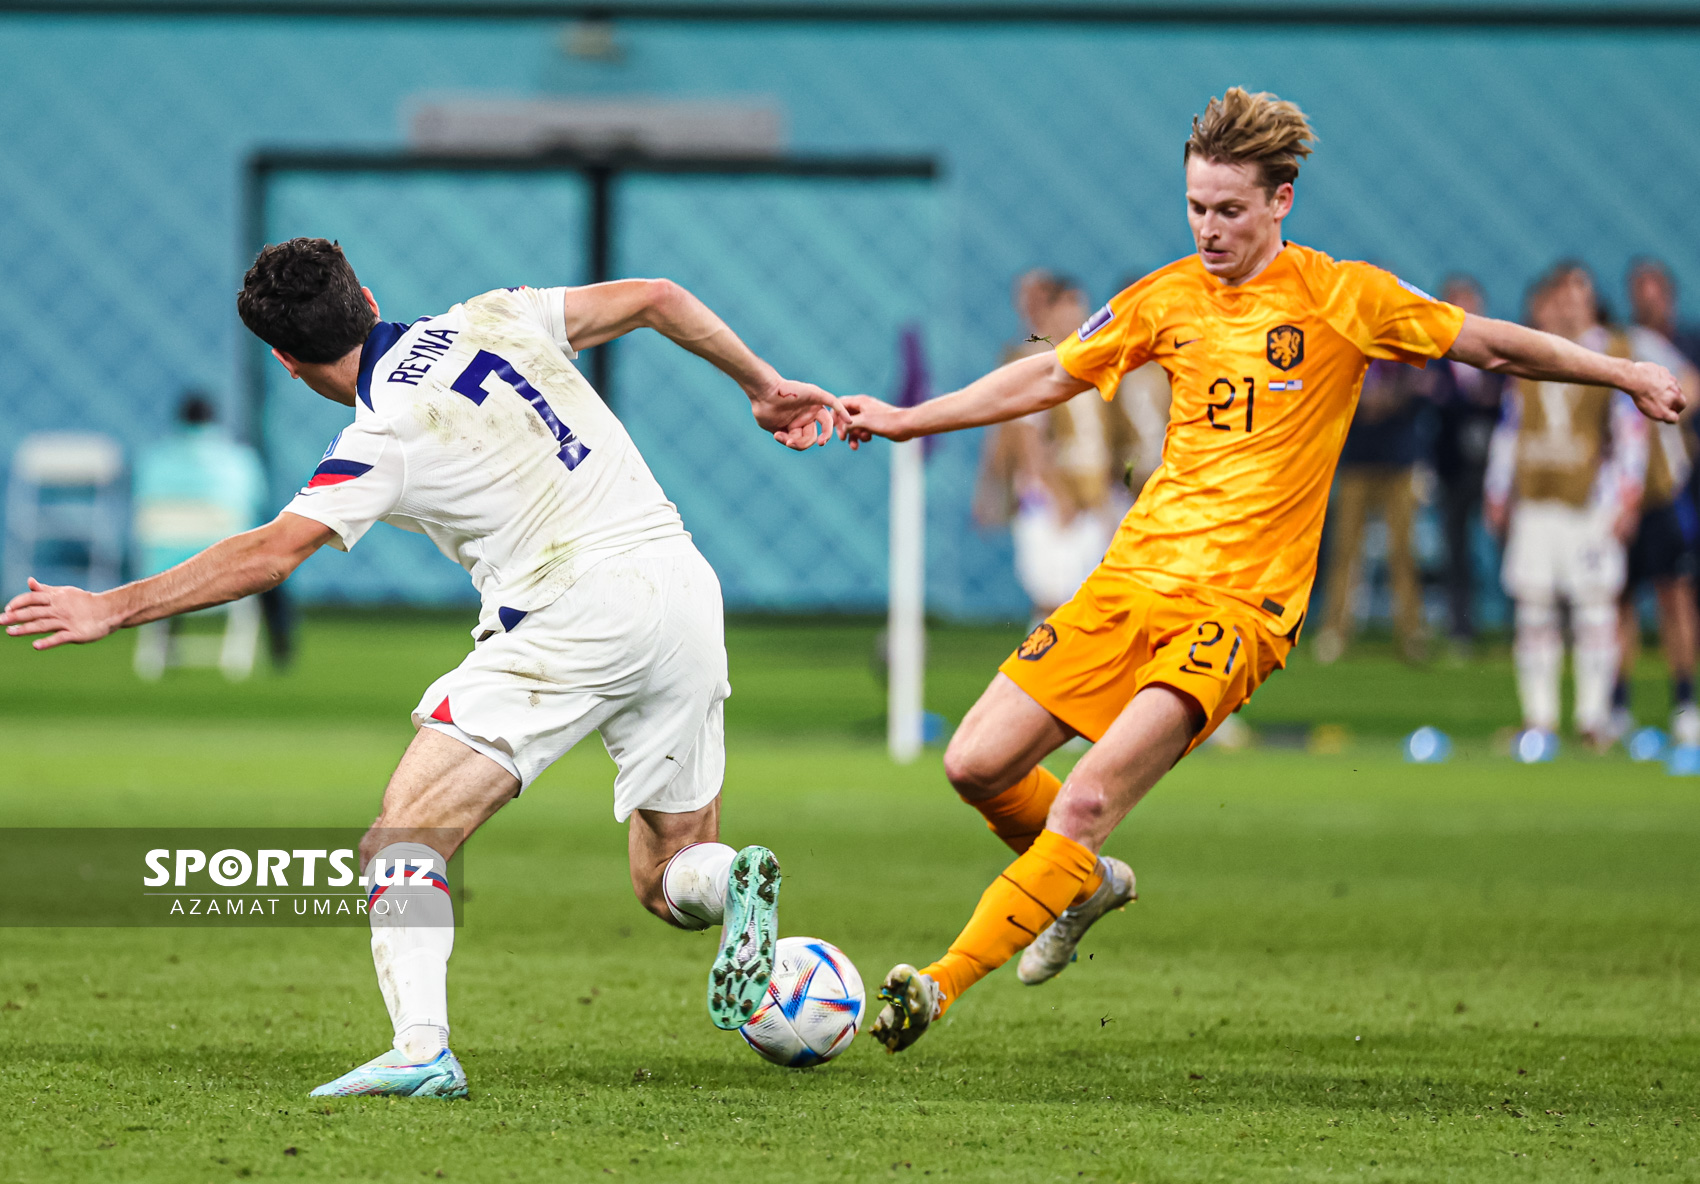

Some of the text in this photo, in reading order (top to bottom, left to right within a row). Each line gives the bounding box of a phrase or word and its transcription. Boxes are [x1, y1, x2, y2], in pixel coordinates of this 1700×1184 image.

[387, 329, 459, 386] REYNA
[450, 349, 592, 471] 7
[1207, 377, 1254, 433] 21
[1188, 621, 1242, 675] 21
